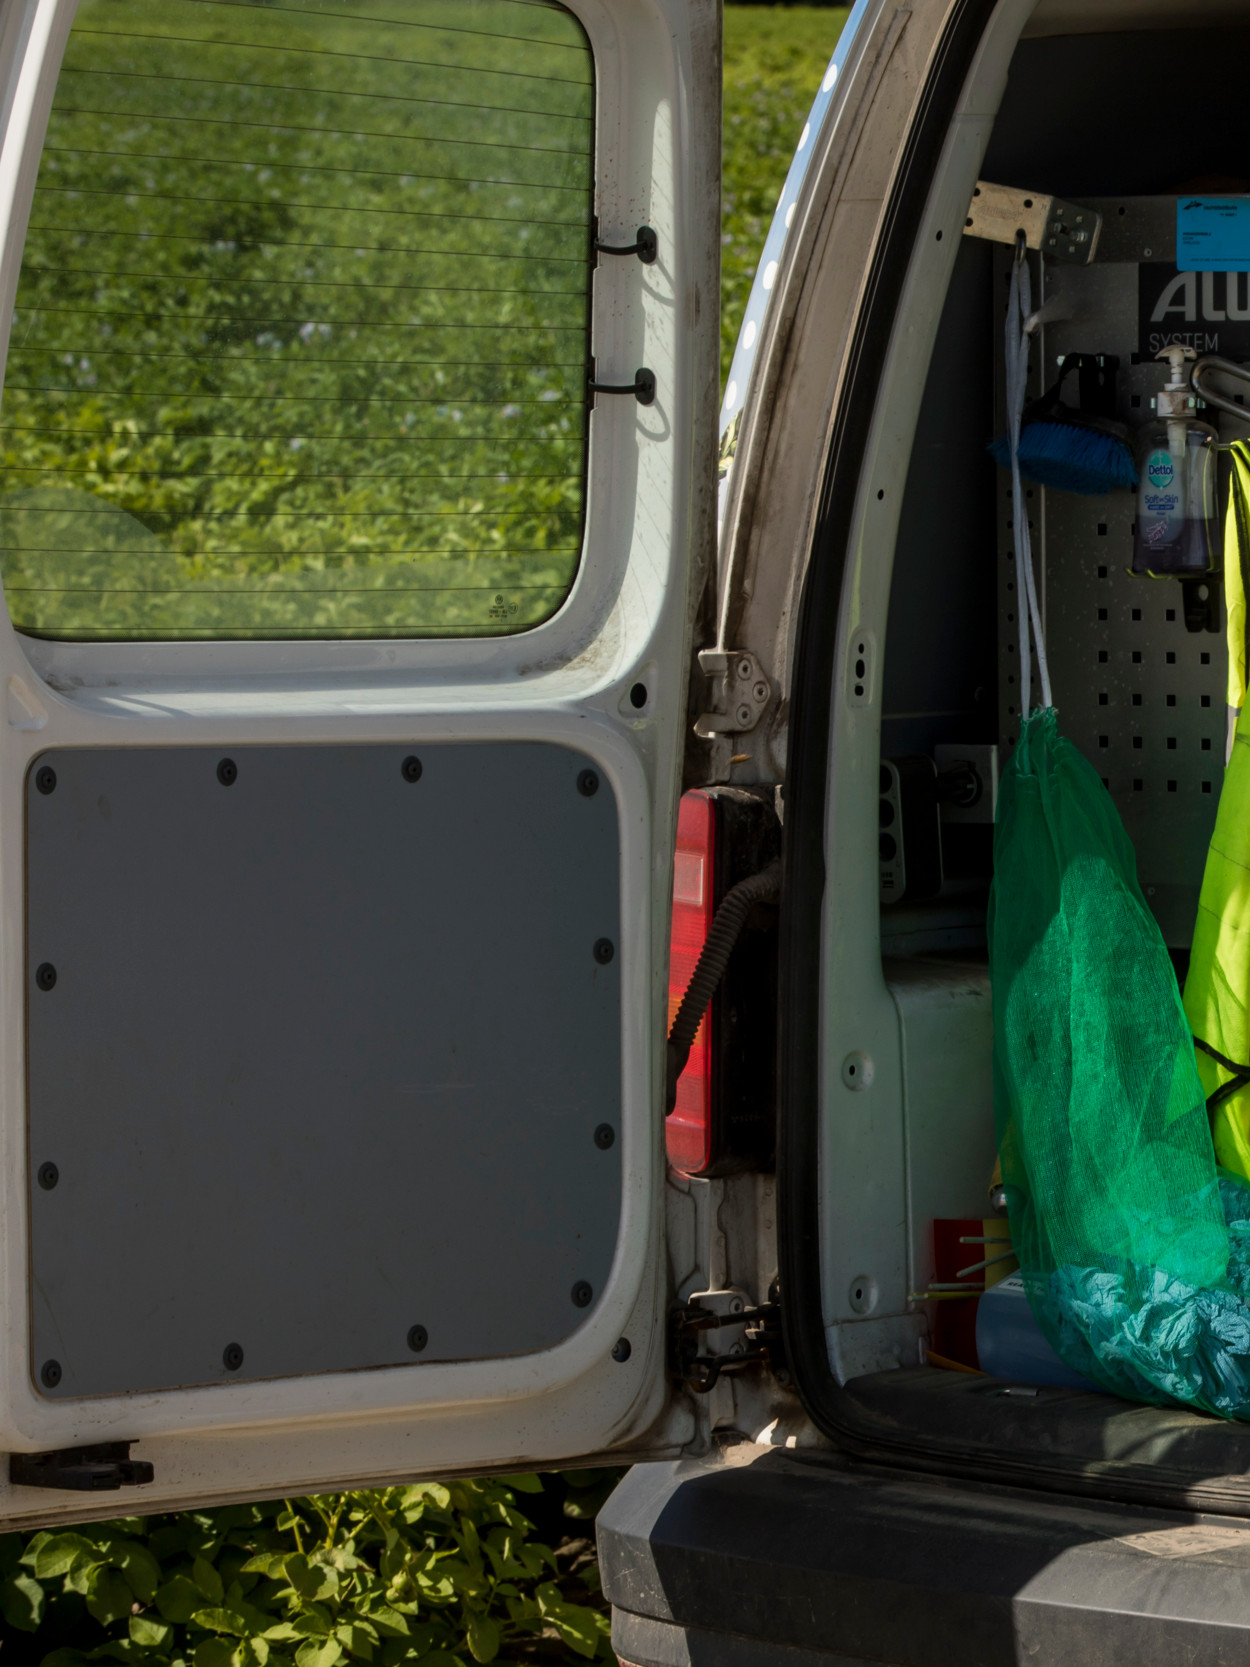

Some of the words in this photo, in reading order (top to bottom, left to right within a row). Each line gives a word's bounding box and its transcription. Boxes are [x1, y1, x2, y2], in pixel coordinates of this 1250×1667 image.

[1150, 332, 1218, 353] SYSTEM
[1148, 464, 1174, 475] Dettol
[1144, 494, 1159, 504] Soft
[1164, 494, 1179, 504] Skin
